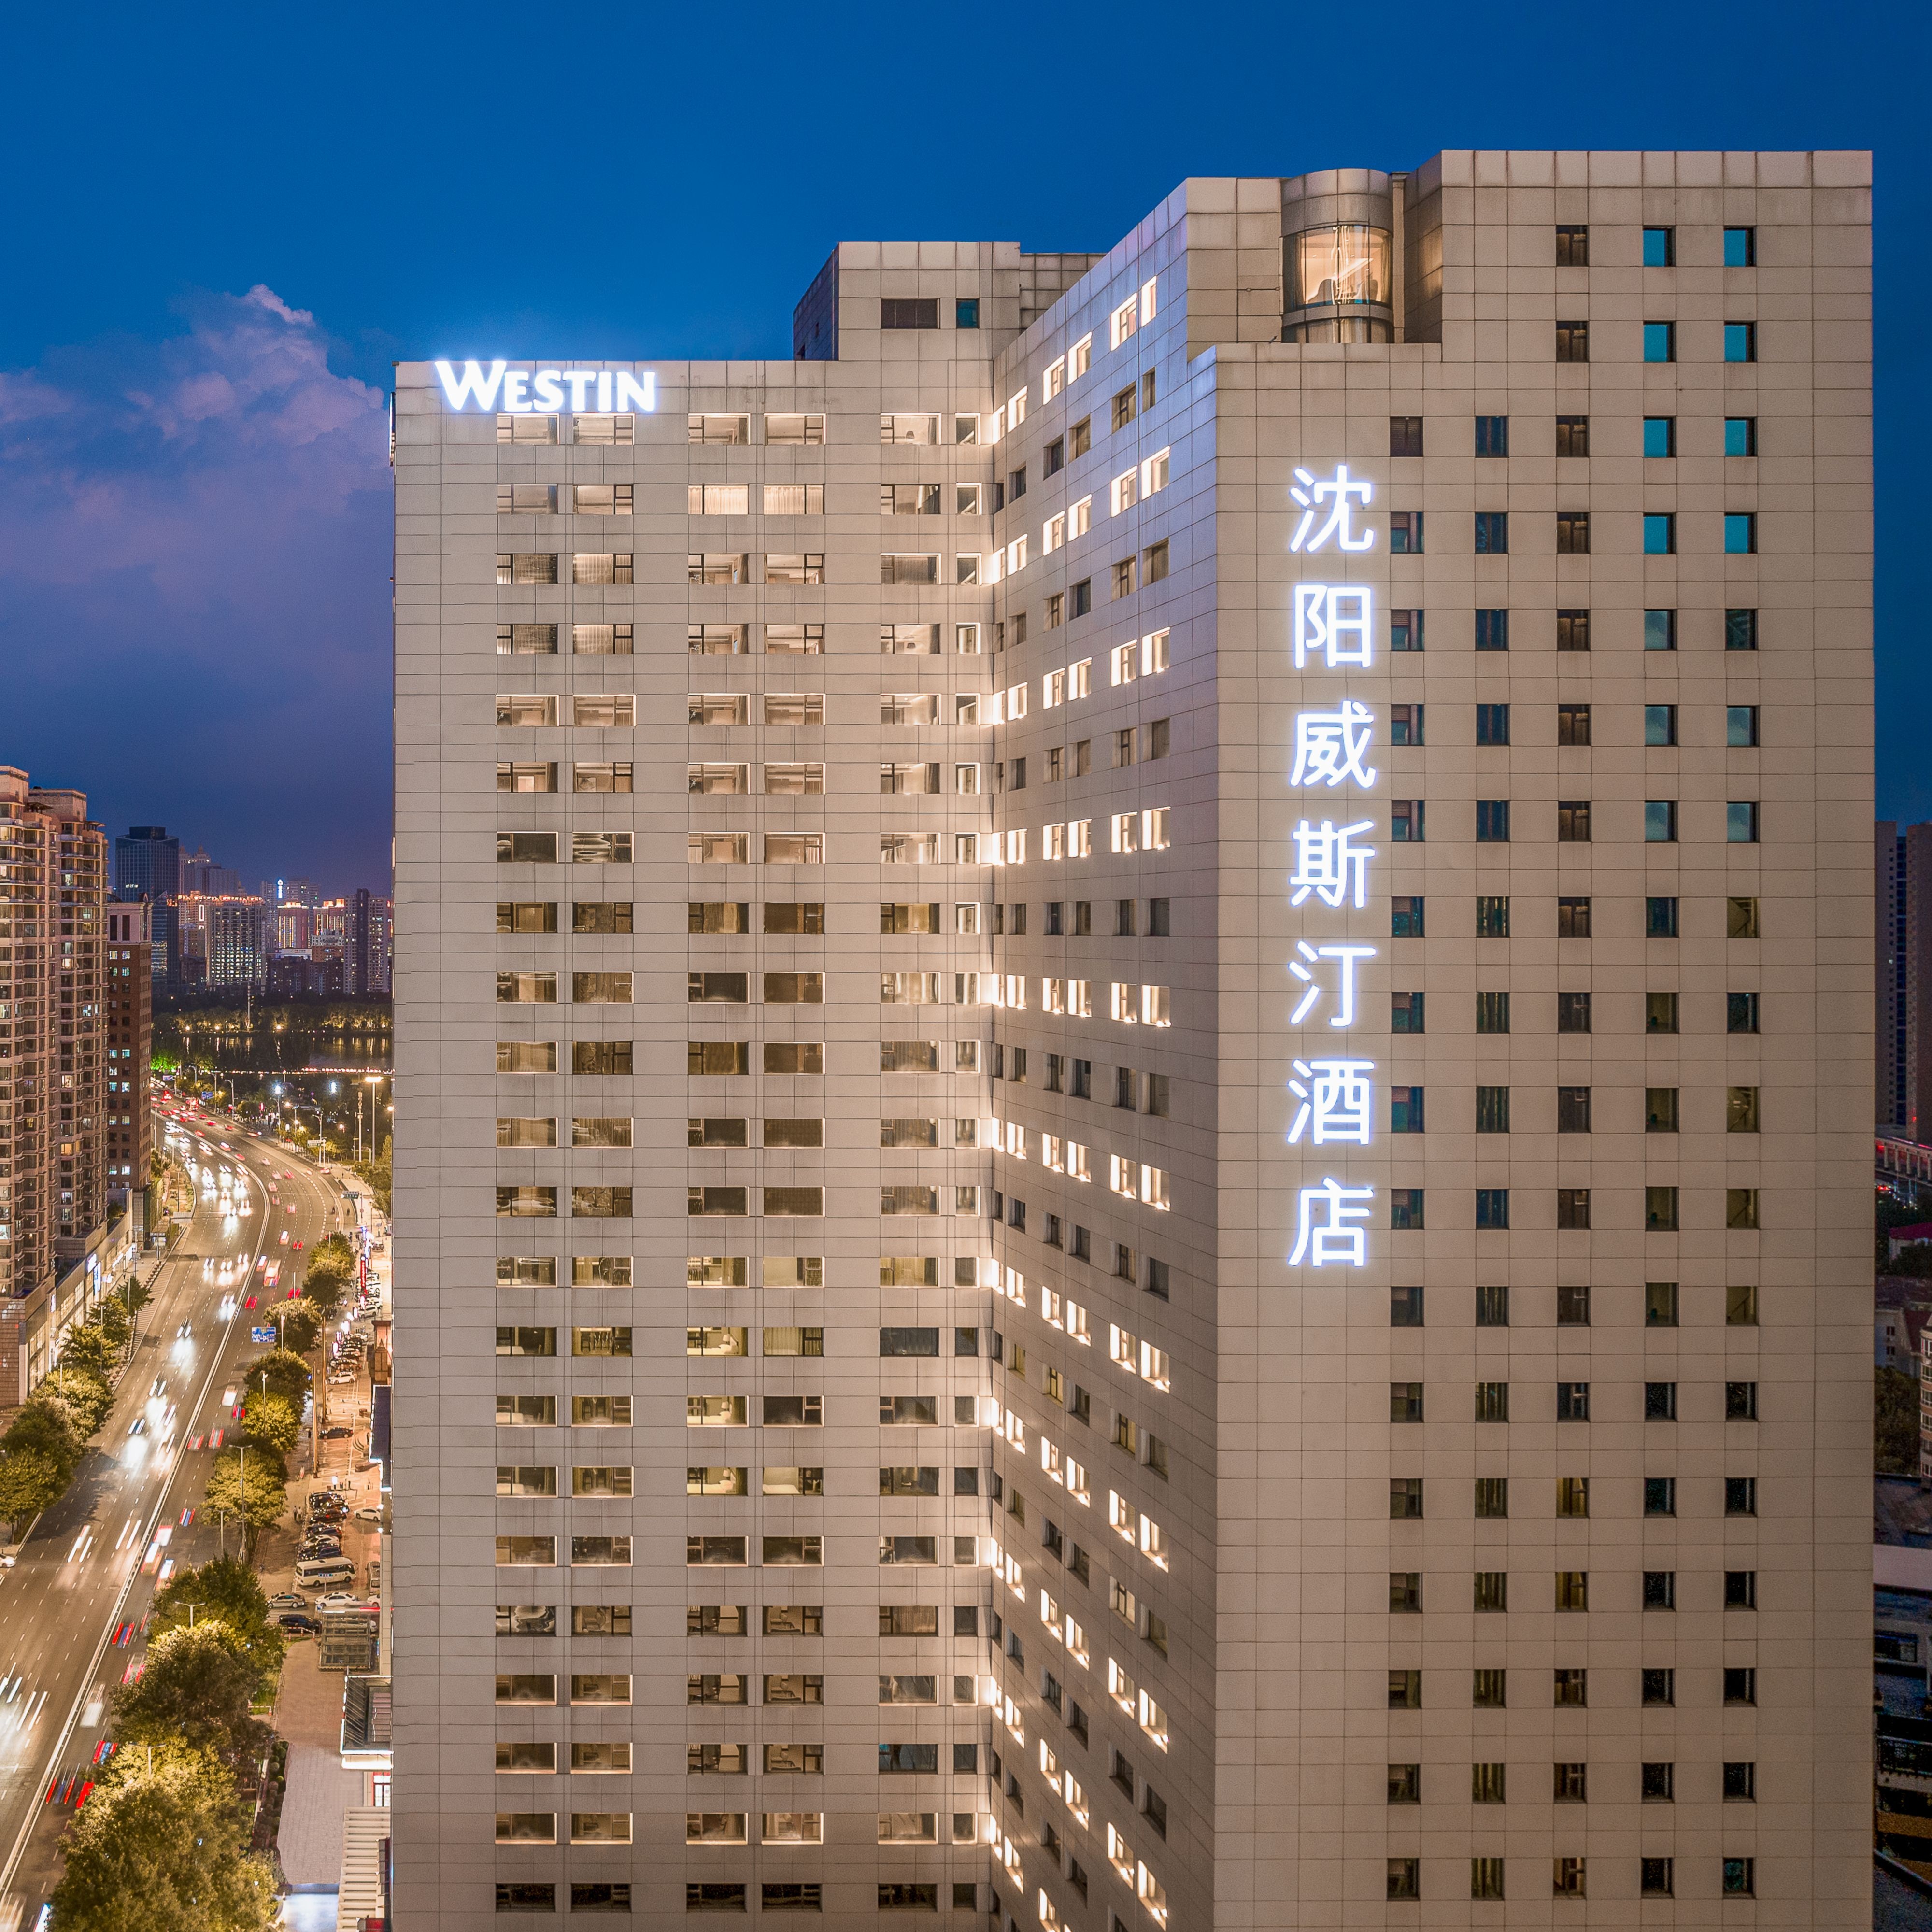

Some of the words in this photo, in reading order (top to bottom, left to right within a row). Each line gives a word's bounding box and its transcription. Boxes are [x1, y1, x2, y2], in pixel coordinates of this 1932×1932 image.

[435, 361, 655, 412] WESTIN
[1288, 465, 1376, 1266] 沈阳威斯汀酒店
